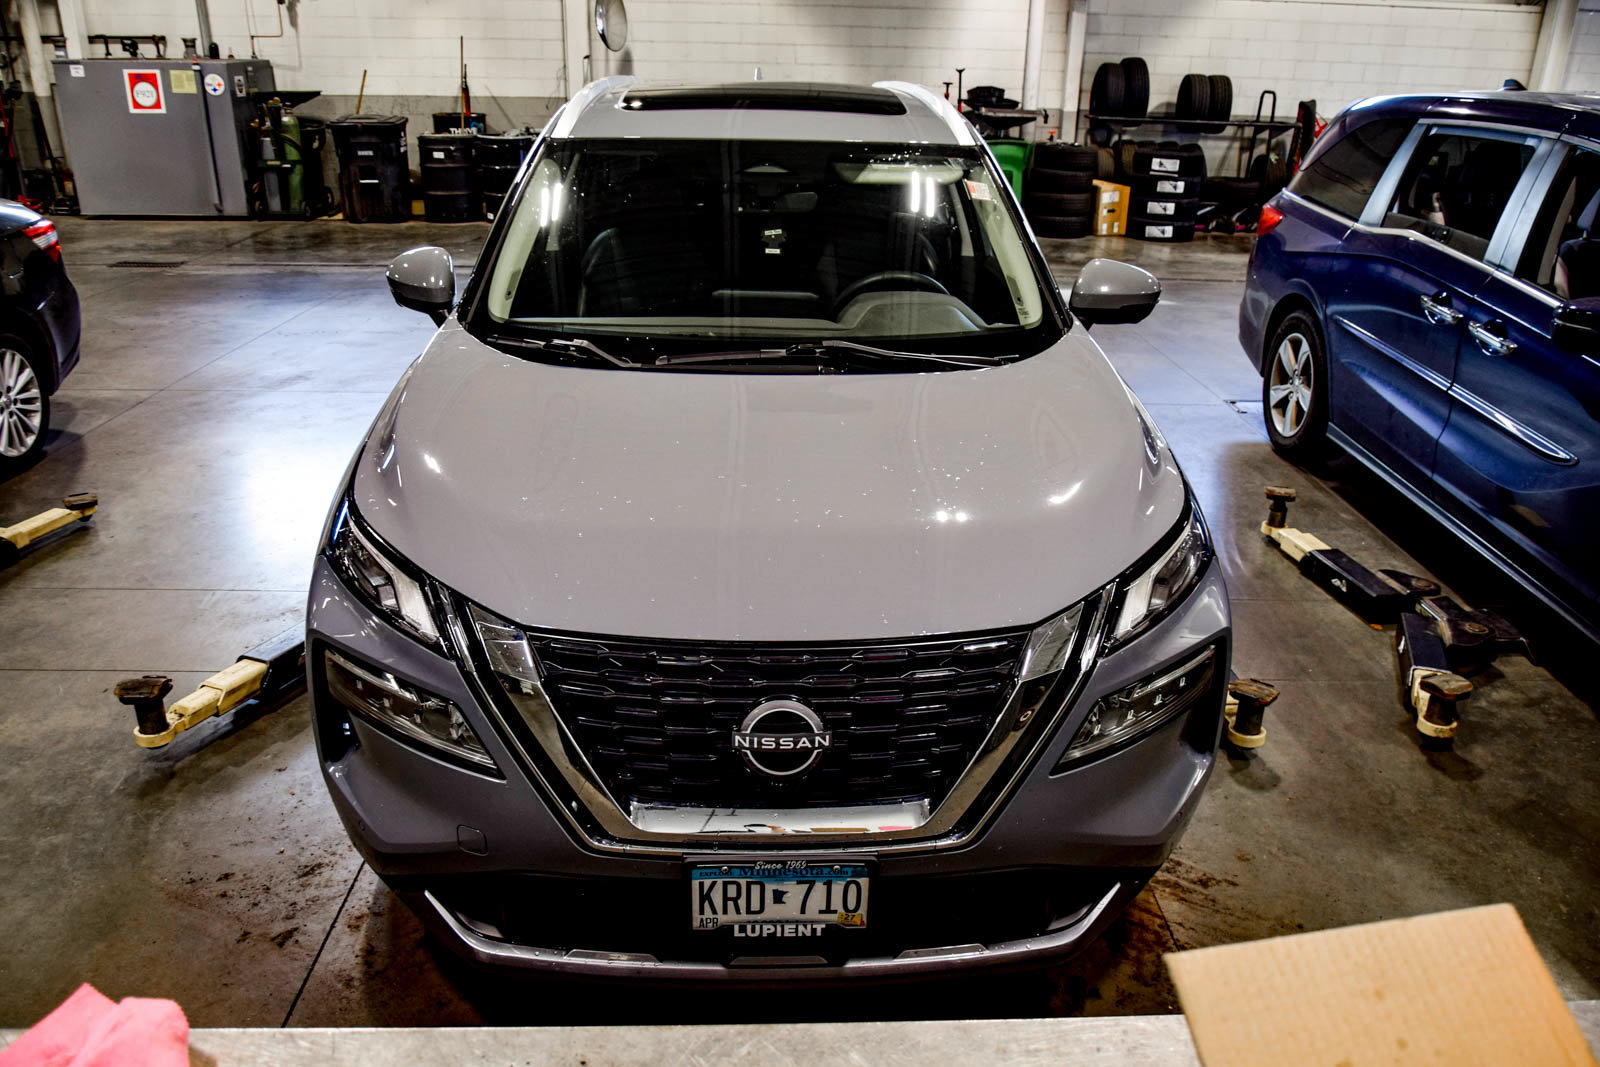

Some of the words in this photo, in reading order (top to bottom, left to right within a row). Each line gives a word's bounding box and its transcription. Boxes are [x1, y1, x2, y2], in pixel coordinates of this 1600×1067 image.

[734, 735, 830, 749] NISSAN
[754, 861, 782, 870] Since
[698, 880, 766, 916] KRD
[796, 879, 862, 915] 710
[699, 916, 719, 929] APR
[844, 913, 856, 921] 27
[733, 923, 826, 938] LUPIENT
